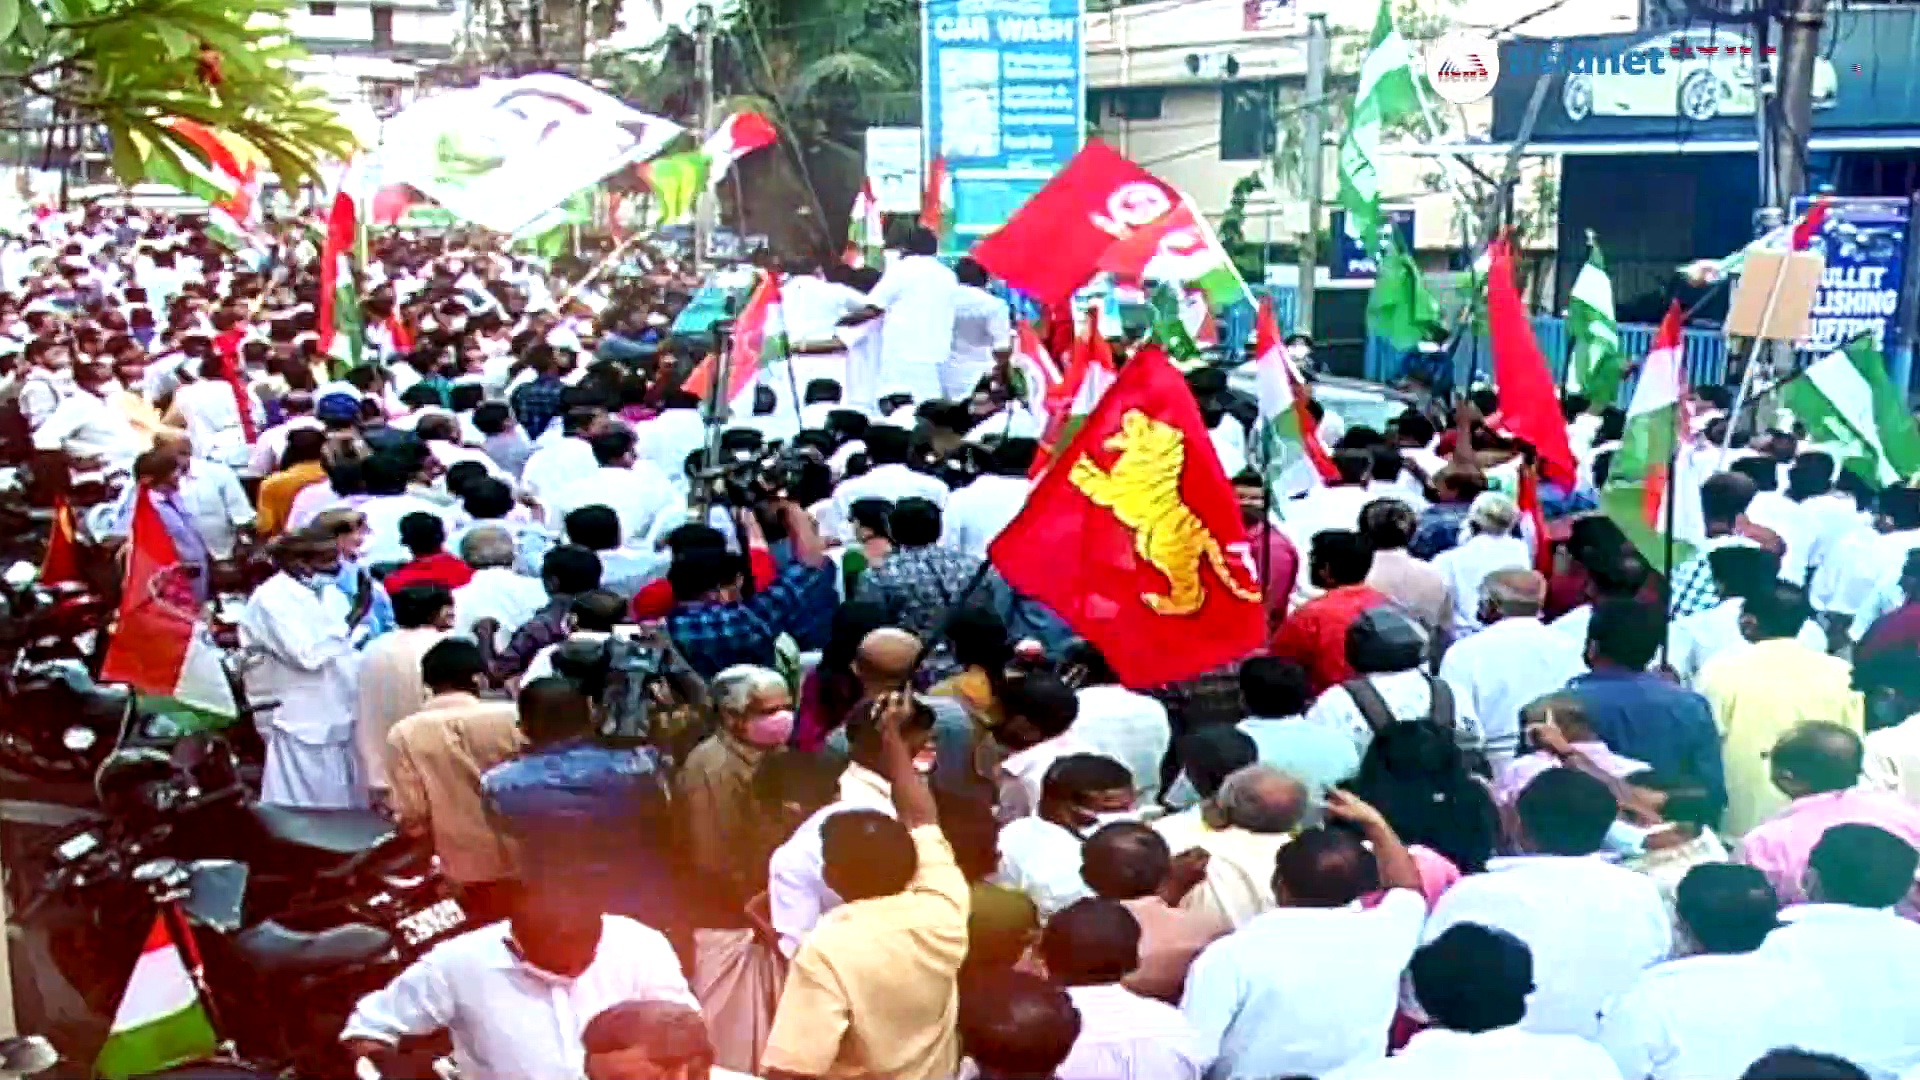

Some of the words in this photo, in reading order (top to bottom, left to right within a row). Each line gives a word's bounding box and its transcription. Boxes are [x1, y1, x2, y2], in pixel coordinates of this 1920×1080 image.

[934, 16, 989, 41] CAR
[997, 16, 1074, 42] WASH
[1822, 266, 1888, 288] ULLET
[1813, 290, 1898, 315] LISHING
